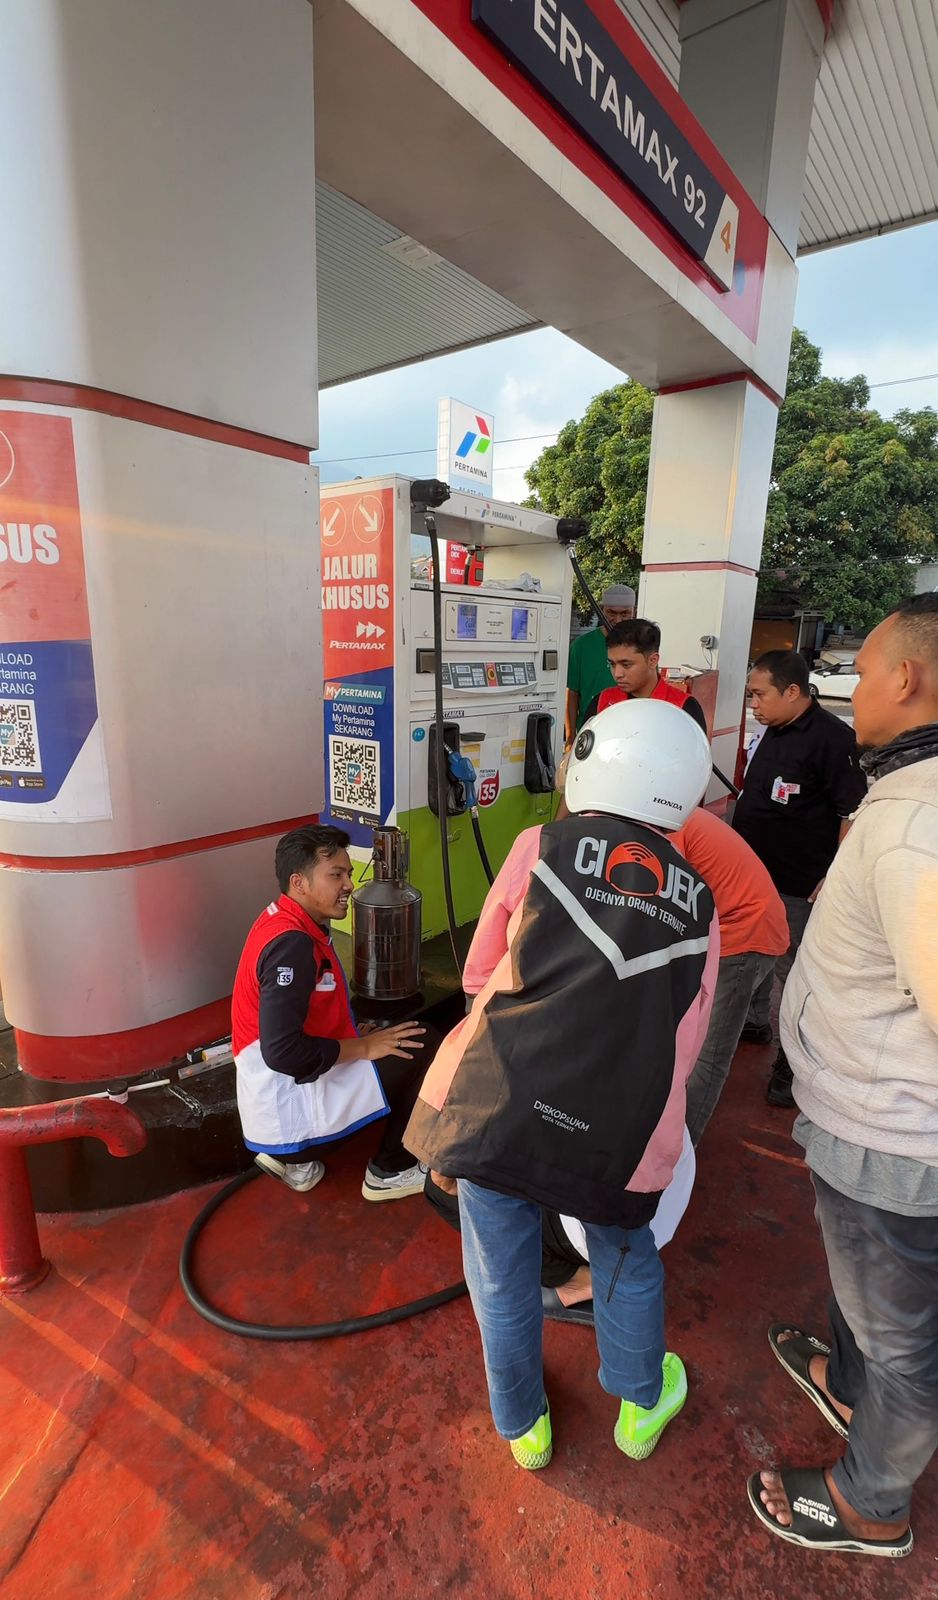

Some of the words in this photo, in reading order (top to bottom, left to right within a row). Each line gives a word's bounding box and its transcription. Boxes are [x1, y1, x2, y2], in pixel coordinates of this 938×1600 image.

[509, 0, 679, 197] ERTAMAX
[683, 174, 706, 229] 92
[720, 220, 732, 254] 4
[454, 461, 488, 479] PERTAMINA
[323, 553, 377, 581] JALUR
[329, 640, 387, 650] PERTAMAX
[0, 653, 33, 665] LOAD
[332, 703, 374, 716] DOWNLOAD
[332, 713, 342, 725] My
[342, 714, 375, 727] Pertamina
[334, 724, 373, 737] SEKARANG
[653, 797, 683, 811] HONDA
[585, 886, 625, 907] OJEKNYA
[627, 896, 658, 918] ORANG
[658, 908, 688, 936] TERNATE
[533, 1100, 590, 1132] DISKOP&UKM
[555, 1120, 575, 1132] TERNATE
[797, 1496, 830, 1512] FASHION
